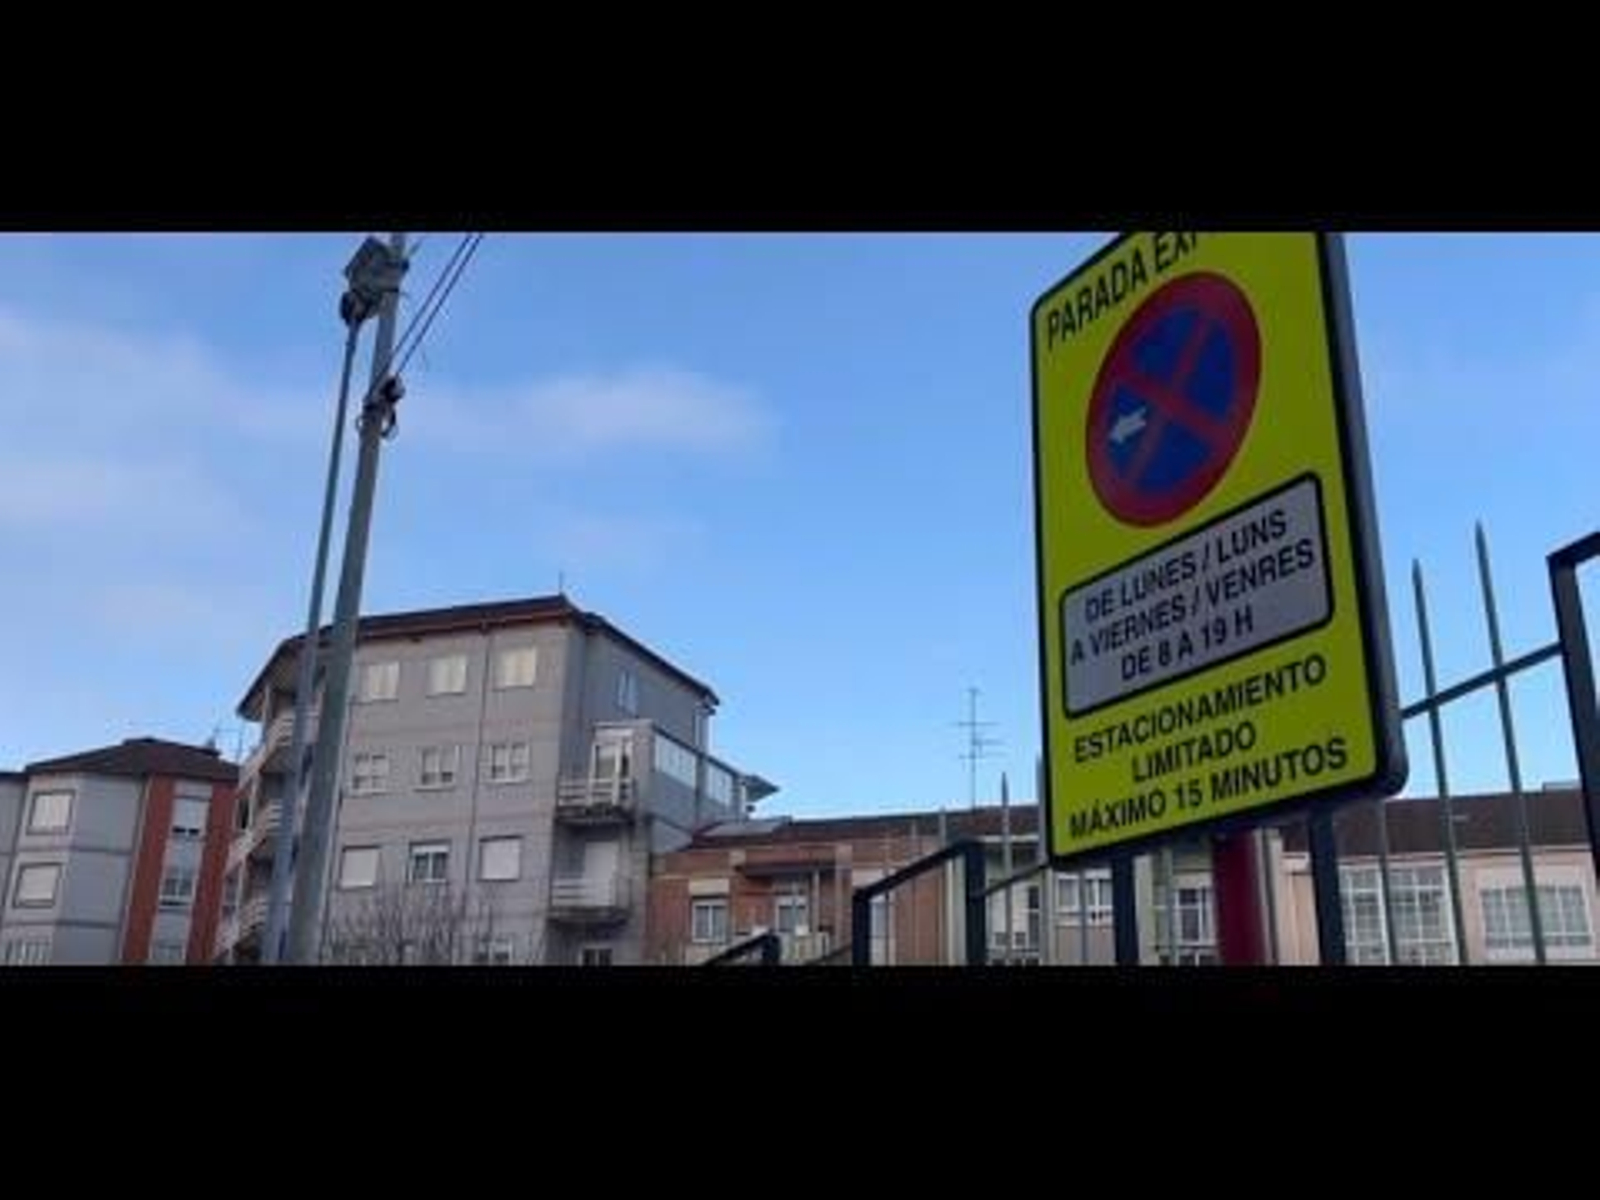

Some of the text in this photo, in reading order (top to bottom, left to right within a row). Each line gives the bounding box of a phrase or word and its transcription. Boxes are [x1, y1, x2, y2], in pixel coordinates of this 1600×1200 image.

[1048, 247, 1148, 350] PARADA
[1071, 639, 1084, 666] A
[1089, 595, 1187, 657] VIERNES
[1204, 538, 1315, 605] VENRES
[1085, 594, 1114, 621] DE
[1121, 553, 1196, 606] LUNES
[1217, 509, 1287, 563] LUNS
[1121, 605, 1254, 681] DE 8 A 19 H
[1074, 653, 1327, 763] ESTACIONAMIENTO
[1131, 721, 1257, 783] LIMITADO
[1069, 737, 1348, 838] MÁXIMO 15 MINUTOS
